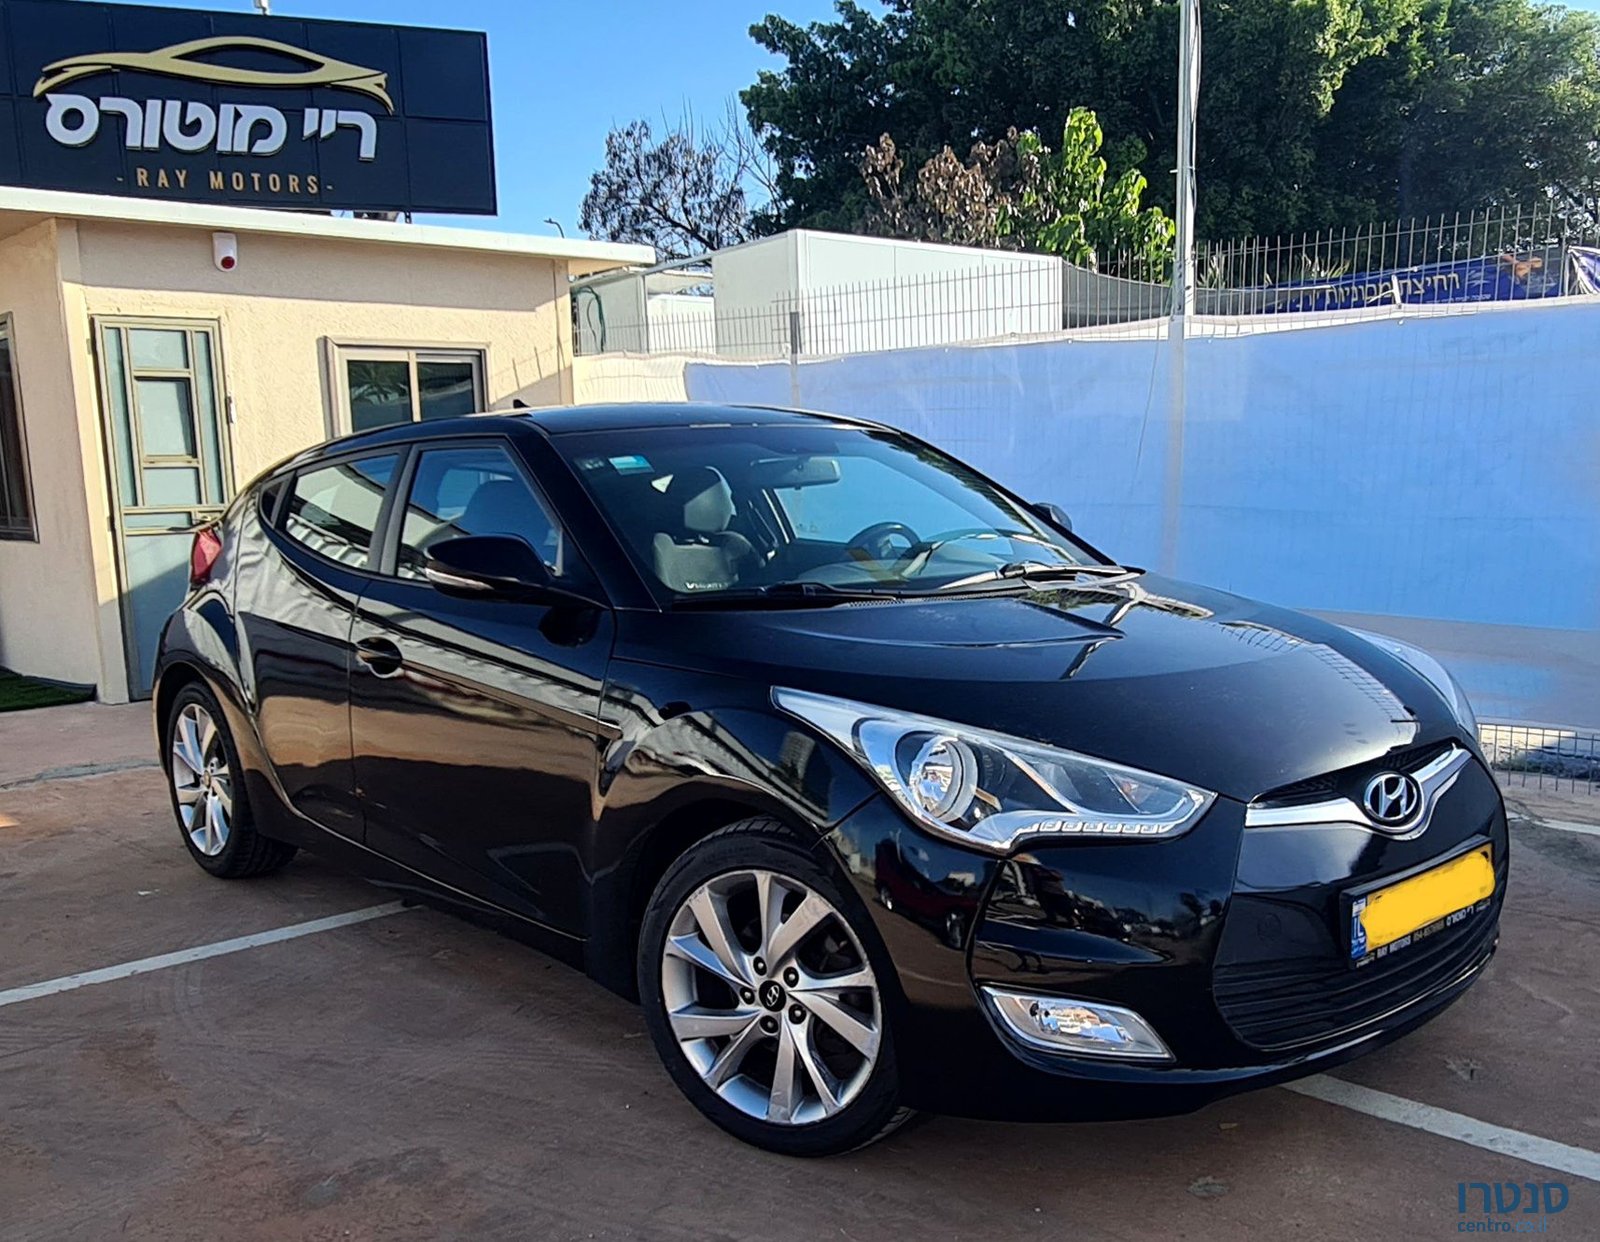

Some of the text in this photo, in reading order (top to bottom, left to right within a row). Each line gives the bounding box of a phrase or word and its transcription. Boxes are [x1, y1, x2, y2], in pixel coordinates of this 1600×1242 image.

[45, 93, 378, 161] ריי מוטורס
[136, 167, 319, 194] RAY MOTORS
